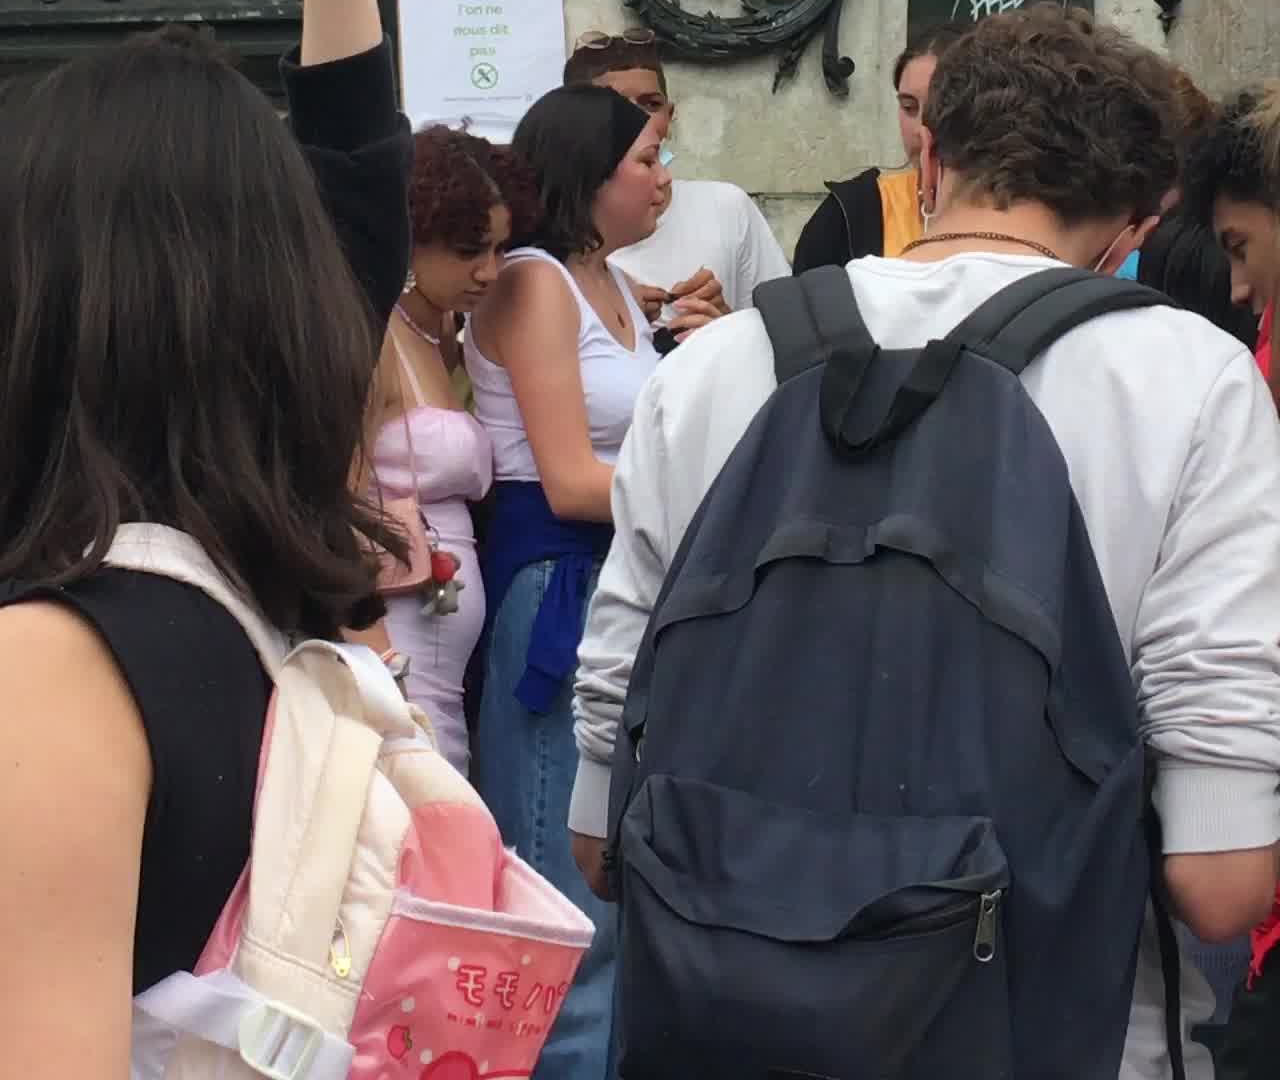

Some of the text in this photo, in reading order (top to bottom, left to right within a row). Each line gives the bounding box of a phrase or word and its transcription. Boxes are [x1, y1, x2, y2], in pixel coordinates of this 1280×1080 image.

[485, 6, 503, 15] ne
[453, 24, 510, 36] nous dit
[470, 47, 496, 58] pas
